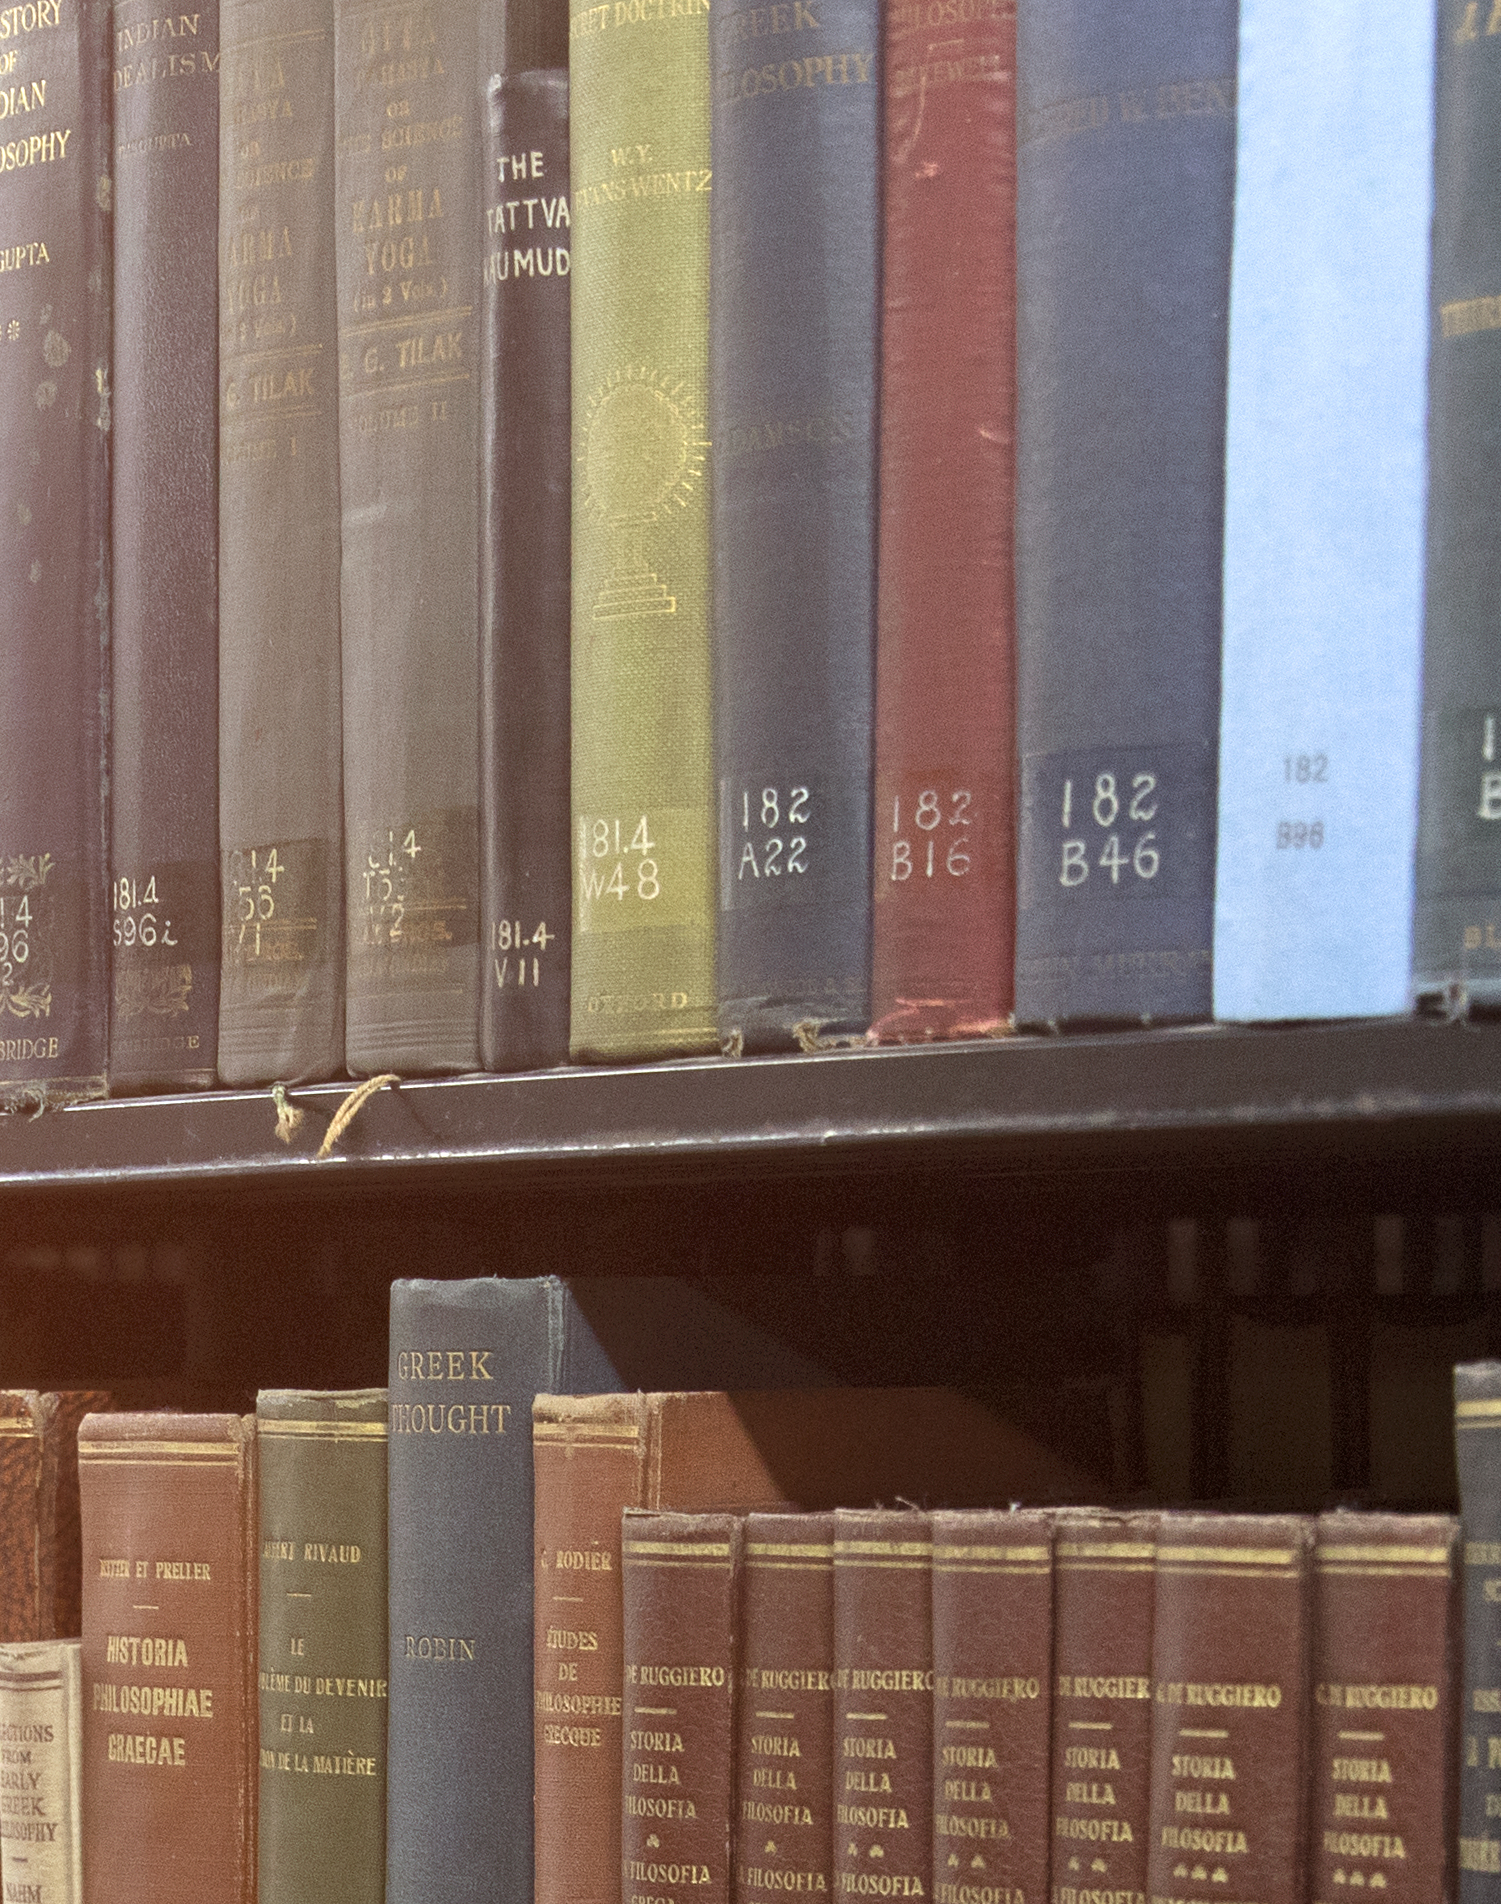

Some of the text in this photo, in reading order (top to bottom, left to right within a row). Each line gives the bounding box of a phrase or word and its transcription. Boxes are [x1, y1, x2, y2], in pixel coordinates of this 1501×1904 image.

[117, 14, 200, 52] INDIAN
[497, 151, 544, 183] THE
[486, 196, 570, 234] TATTVA
[398, 333, 463, 367] TILAK
[740, 787, 811, 828] 182
[1062, 773, 1157, 828] 182
[581, 816, 656, 858] 181.4
[739, 837, 809, 878] A22
[889, 838, 971, 881] B16
[1059, 835, 1160, 886] B46
[581, 859, 660, 902] W48
[113, 876, 159, 910] 181.4
[489, 921, 554, 951] 181.4
[398, 1350, 493, 1382] GREEK
[392, 1403, 511, 1435] THOUGHT
[304, 1545, 361, 1563] RIVAUD
[136, 1561, 211, 1582] ET PRELLER
[107, 1637, 188, 1667] HISTORIA
[292, 1638, 304, 1655] LE
[404, 1636, 477, 1661] ROBIN
[559, 1662, 578, 1682] DE
[640, 1667, 725, 1687] RUGGIERO
[295, 1676, 387, 1697] DU DEVENIR
[951, 1677, 1040, 1700] RUGGIERO
[93, 1684, 214, 1719] PHILOSOPHIAE
[299, 1717, 314, 1733] LA
[108, 1734, 186, 1766] GRAECAE
[630, 1732, 684, 1753] STORIA
[751, 1737, 801, 1758] STORIA
[843, 1738, 897, 1760] STORIA
[313, 1751, 376, 1775] MATIÈRE
[942, 1747, 997, 1768] STORIA
[633, 1764, 681, 1784] DELLA
[753, 1770, 797, 1790] DELLA
[845, 1772, 892, 1793] DELLA
[742, 1802, 814, 1825] FILOSOFIA
[1175, 1792, 1231, 1815] DELLA
[629, 1864, 712, 1885] FILOSOFIA
[748, 1870, 827, 1893] FILOSOFIA
[841, 1873, 924, 1896] FILOSOFIA
